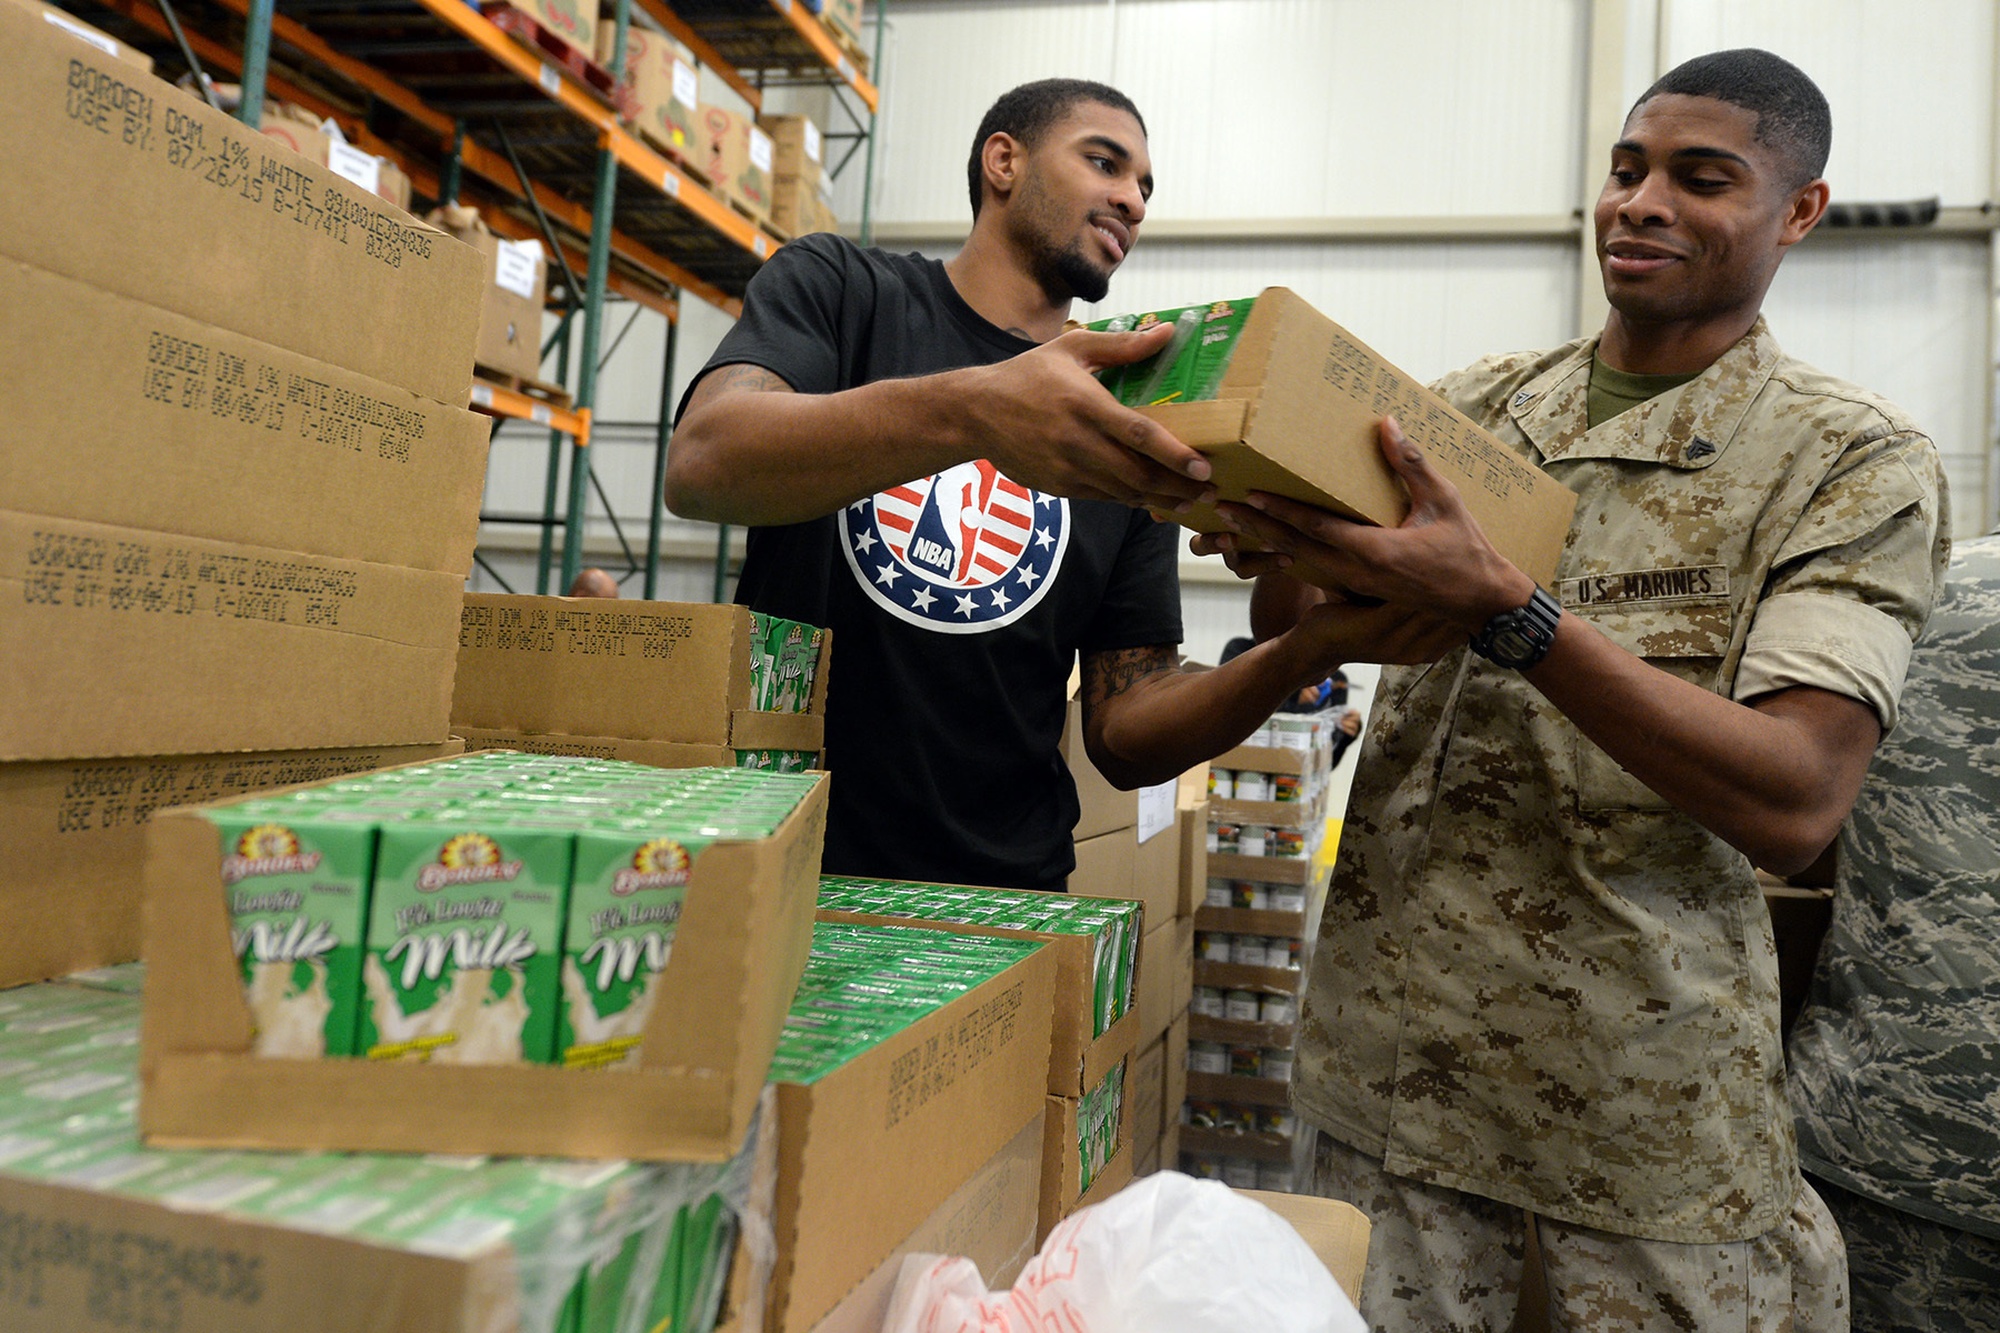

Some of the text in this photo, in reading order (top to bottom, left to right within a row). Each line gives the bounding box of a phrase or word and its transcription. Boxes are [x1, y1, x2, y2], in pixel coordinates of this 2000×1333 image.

[68, 60, 153, 122] BORDEN
[166, 107, 206, 150] DOM.
[220, 137, 249, 169] 1%
[260, 155, 313, 201] WHITE
[66, 90, 110, 134] USE
[123, 117, 155, 151] BY:
[167, 139, 263, 203] 07/26/15
[273, 187, 350, 246] B-1774T1
[149, 331, 210, 376] BORDEN
[254, 364, 281, 398] 1%
[286, 373, 330, 412] WHITE
[1322, 359, 1349, 392] USE
[1329, 334, 1376, 379] BORDEN
[1425, 403, 1460, 440] WHITE
[143, 366, 177, 404] USE
[210, 384, 286, 432] 08/06/15
[29, 531, 106, 573] BORDEN
[160, 549, 194, 581] 1%
[196, 553, 248, 587] WHITE
[912, 537, 952, 570] NBA
[24, 571, 68, 605] USE
[108, 578, 197, 616] 08/06/15
[1623, 568, 1712, 600] MARINES
[461, 606, 493, 632] RDEN
[530, 609, 549, 631] 1%
[555, 611, 592, 634] WHITE
[66, 762, 136, 799] BORDEN
[220, 758, 273, 788] WHITE
[58, 799, 94, 832] USE
[384, 919, 538, 990] Milk
[579, 930, 675, 992] Mi
[958, 1008, 980, 1047] WHITE
